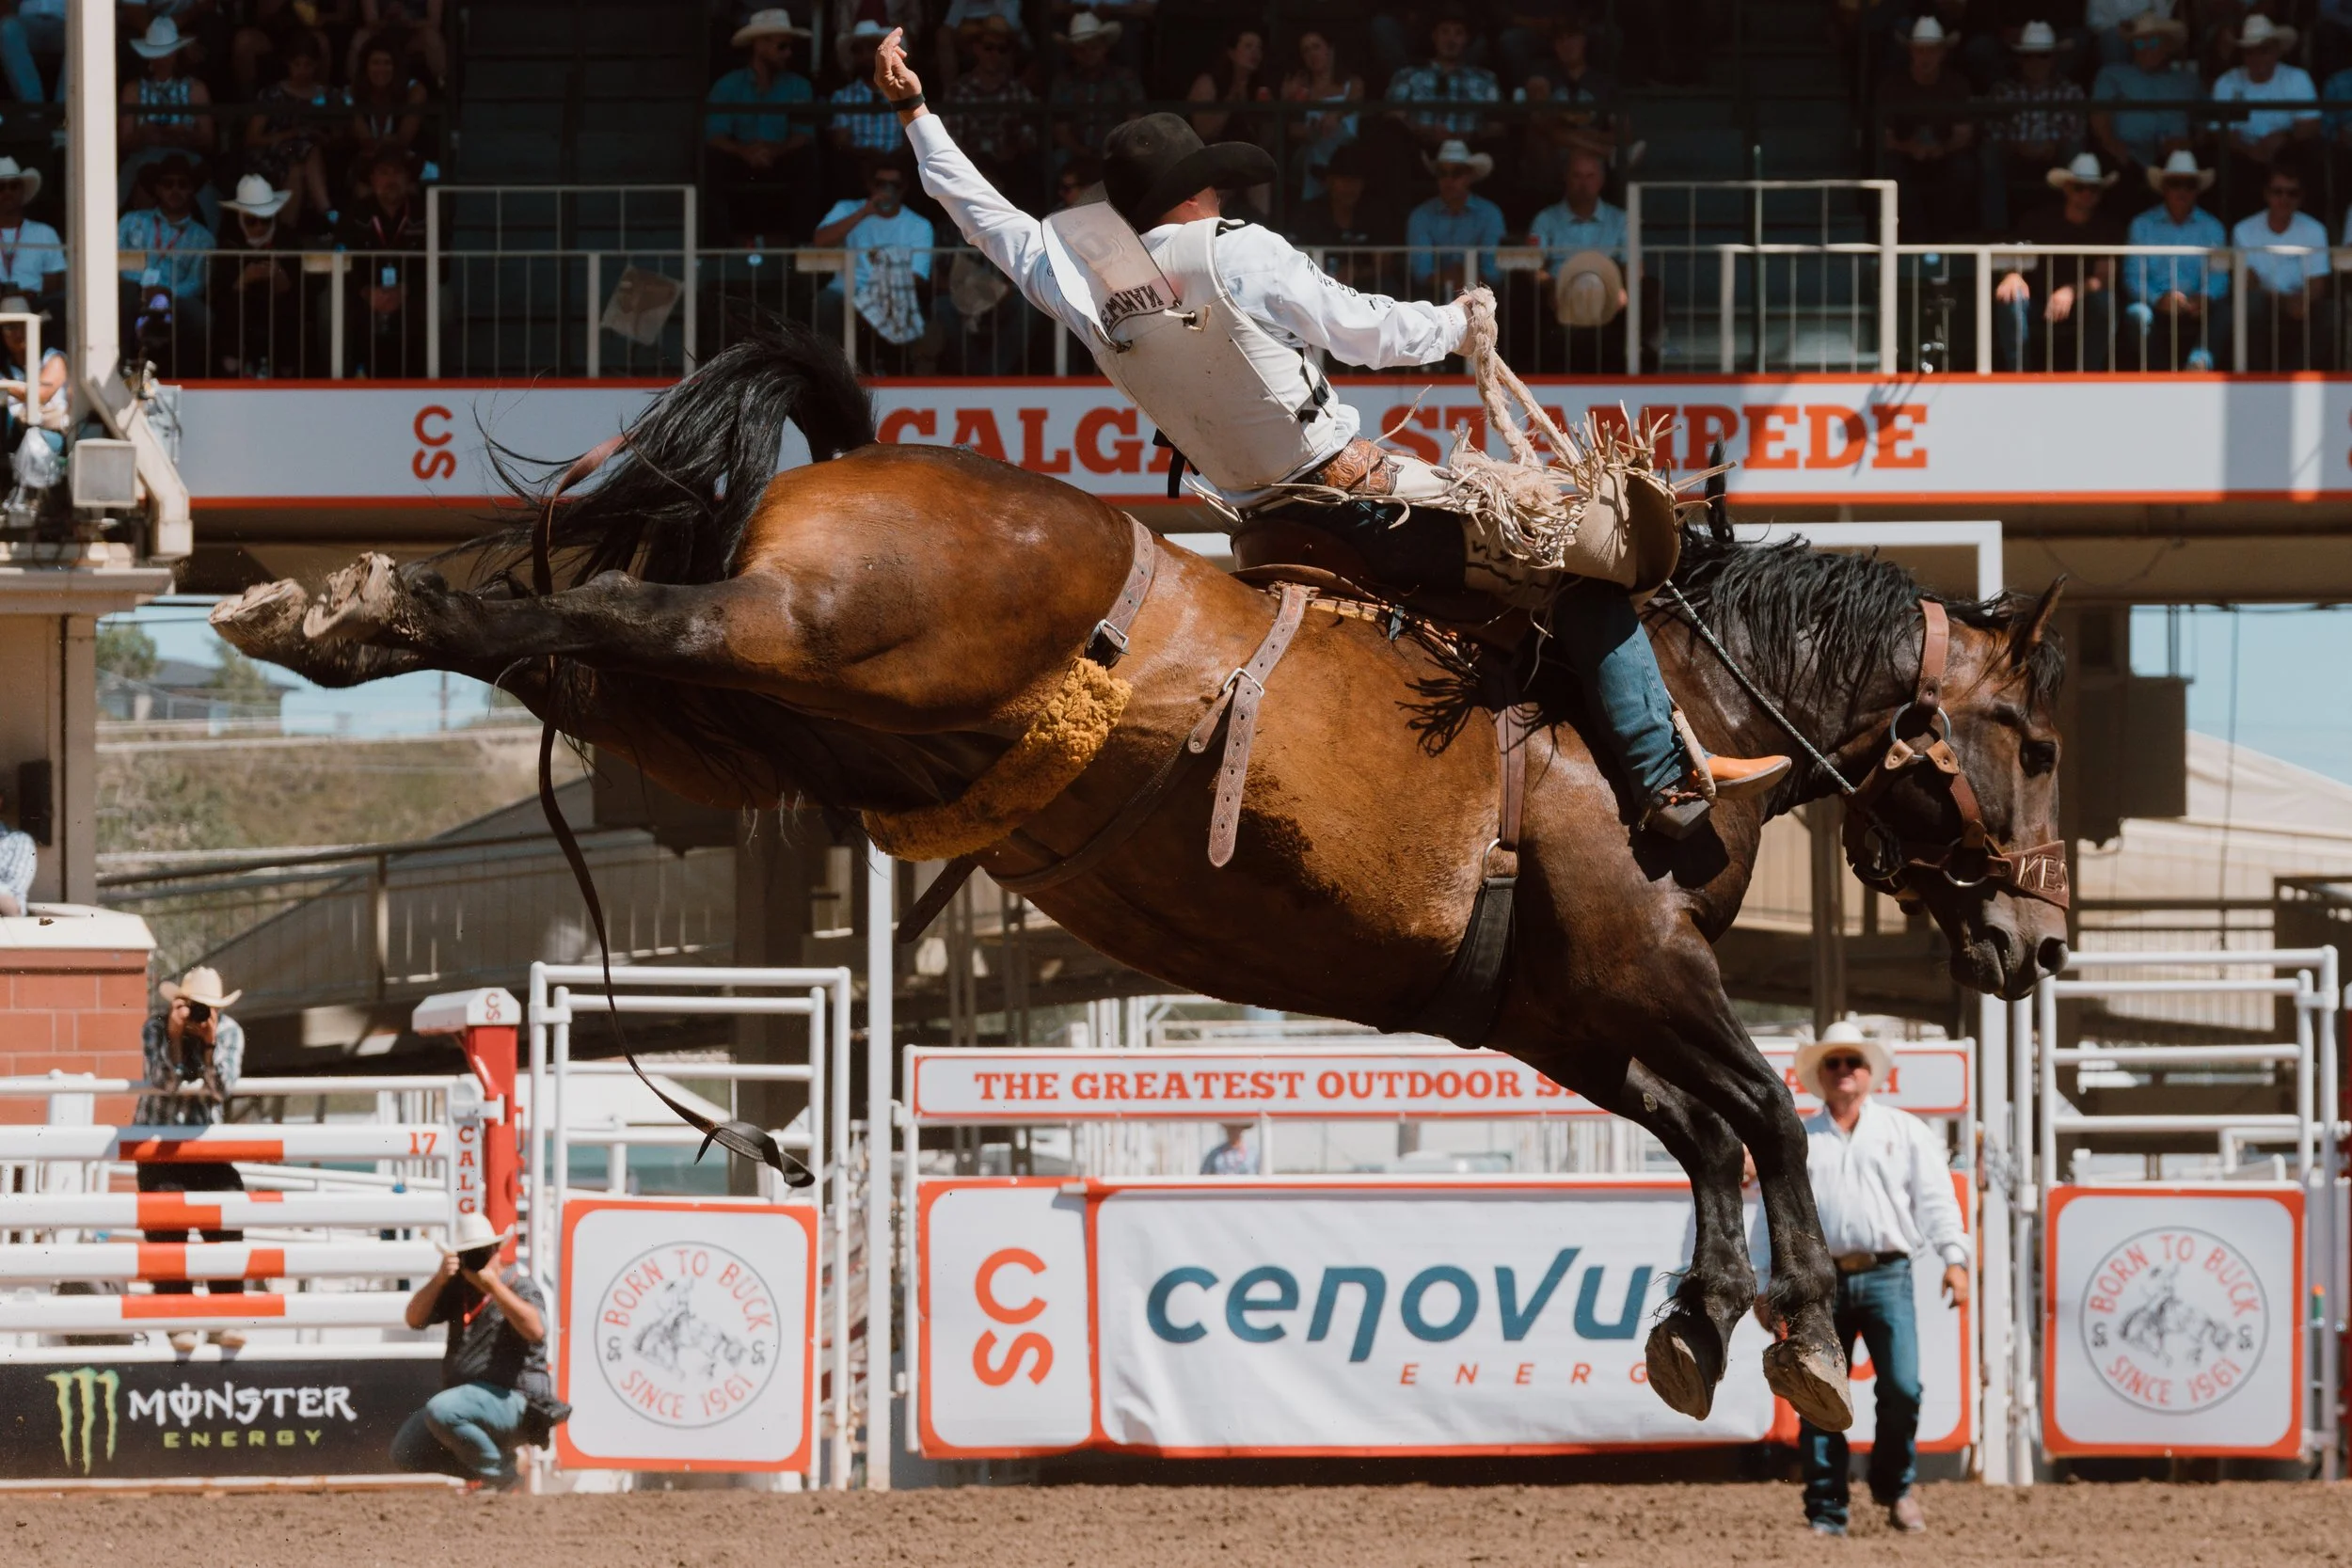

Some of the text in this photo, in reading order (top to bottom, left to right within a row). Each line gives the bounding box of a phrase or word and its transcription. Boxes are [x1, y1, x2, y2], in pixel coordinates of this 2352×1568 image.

[877, 406, 1191, 475] CALG
[975, 1072, 1059, 1101] THE
[1072, 1070, 1305, 1101] GREATEST
[1317, 1069, 1522, 1100] OUTDOOR
[408, 1132, 437, 1155] 17
[458, 1127, 475, 1213] CALG
[603, 1249, 773, 1332] BORN TO BUCK
[2089, 1234, 2260, 1318] BORN TO BUCK
[1147, 1247, 1690, 1362] cenovu
[620, 1370, 755, 1419] SINCE 1961
[1400, 1363, 1648, 1386] ENERG
[2106, 1354, 2242, 1406] SINCE 1961
[128, 1381, 358, 1428] MONSTER
[163, 1429, 323, 1449] ENERGY
